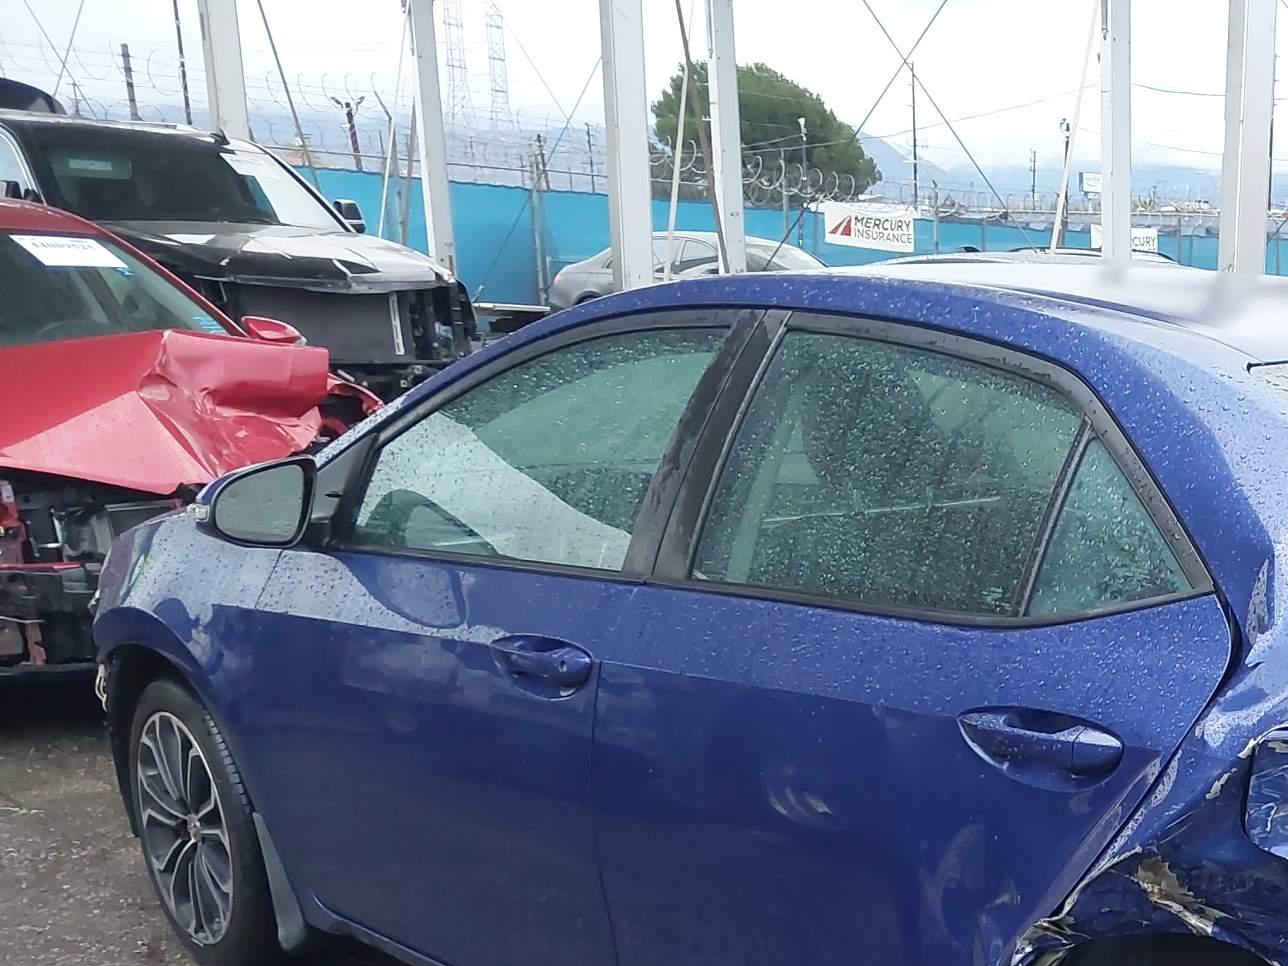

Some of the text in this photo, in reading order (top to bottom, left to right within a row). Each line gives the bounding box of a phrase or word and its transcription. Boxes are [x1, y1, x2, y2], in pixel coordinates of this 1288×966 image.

[854, 215, 911, 232] MERCURY
[854, 228, 913, 244] INSURANCE
[1131, 236, 1156, 247] CURY
